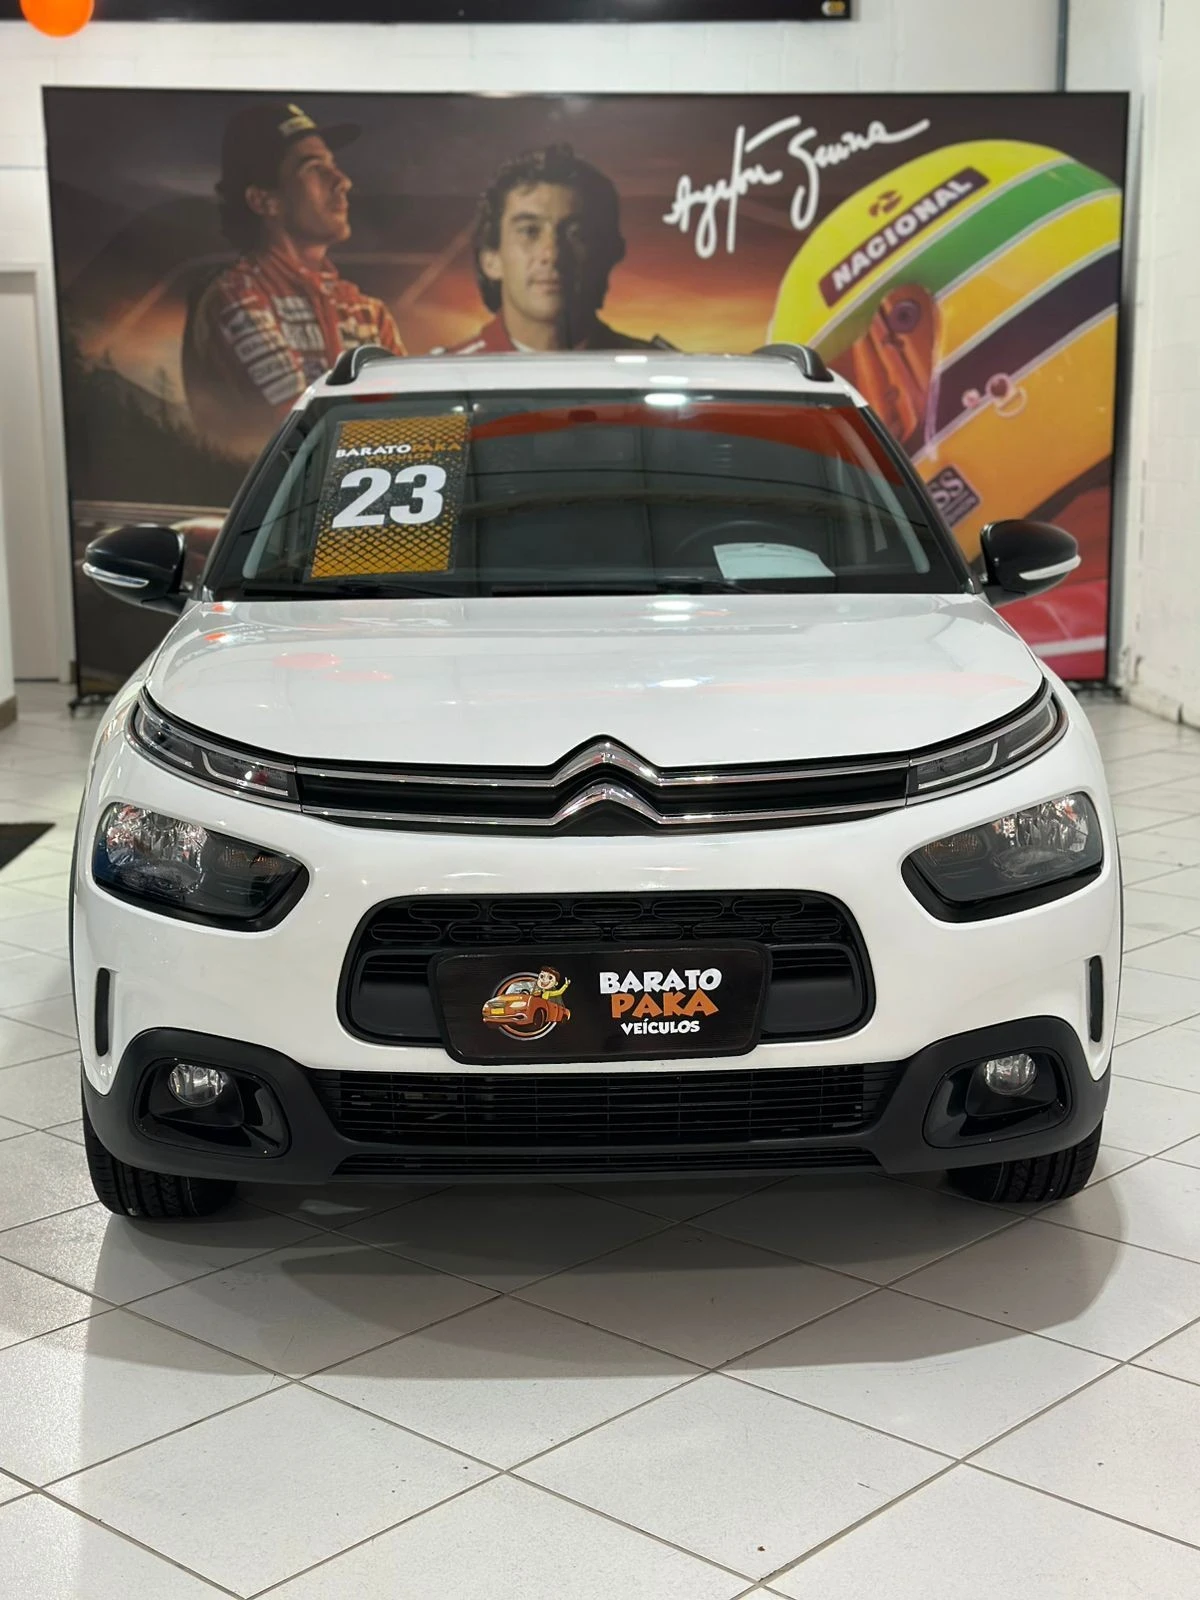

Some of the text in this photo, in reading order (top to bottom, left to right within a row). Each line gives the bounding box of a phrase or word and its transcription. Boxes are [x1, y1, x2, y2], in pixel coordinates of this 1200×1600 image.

[831, 180, 974, 292] NACIONAL
[331, 464, 447, 529] 23
[599, 967, 723, 994] BARATO
[611, 987, 720, 1019] PAKA
[620, 1017, 701, 1036] VEÍCULOS
